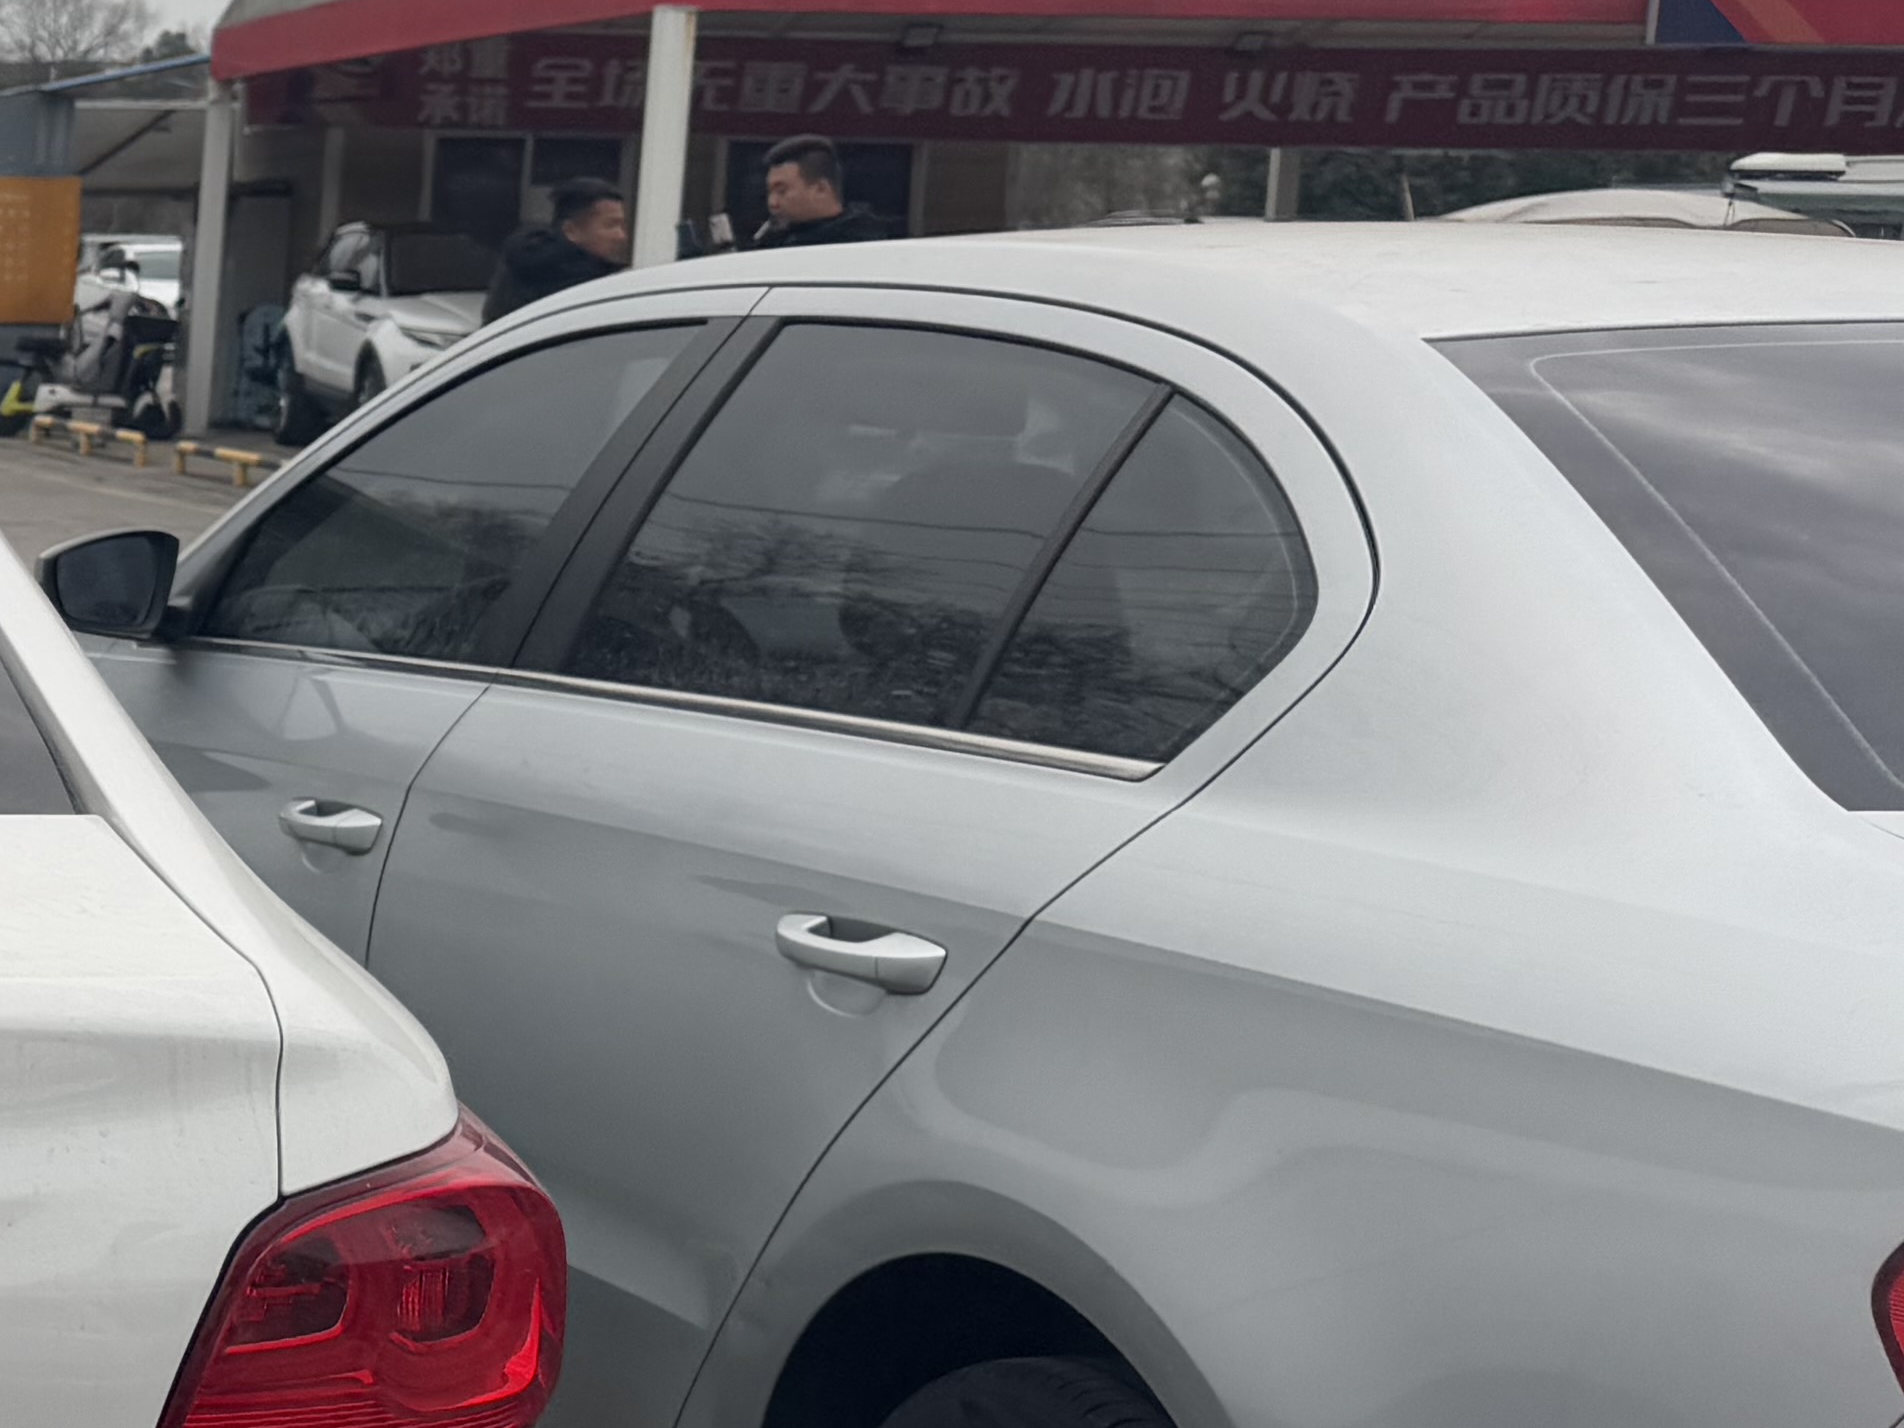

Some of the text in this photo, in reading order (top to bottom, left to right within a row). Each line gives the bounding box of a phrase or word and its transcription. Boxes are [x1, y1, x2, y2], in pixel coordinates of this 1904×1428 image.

[1218, 68, 1360, 123] 火烧
[1384, 72, 1904, 129] 产品质保三个月
